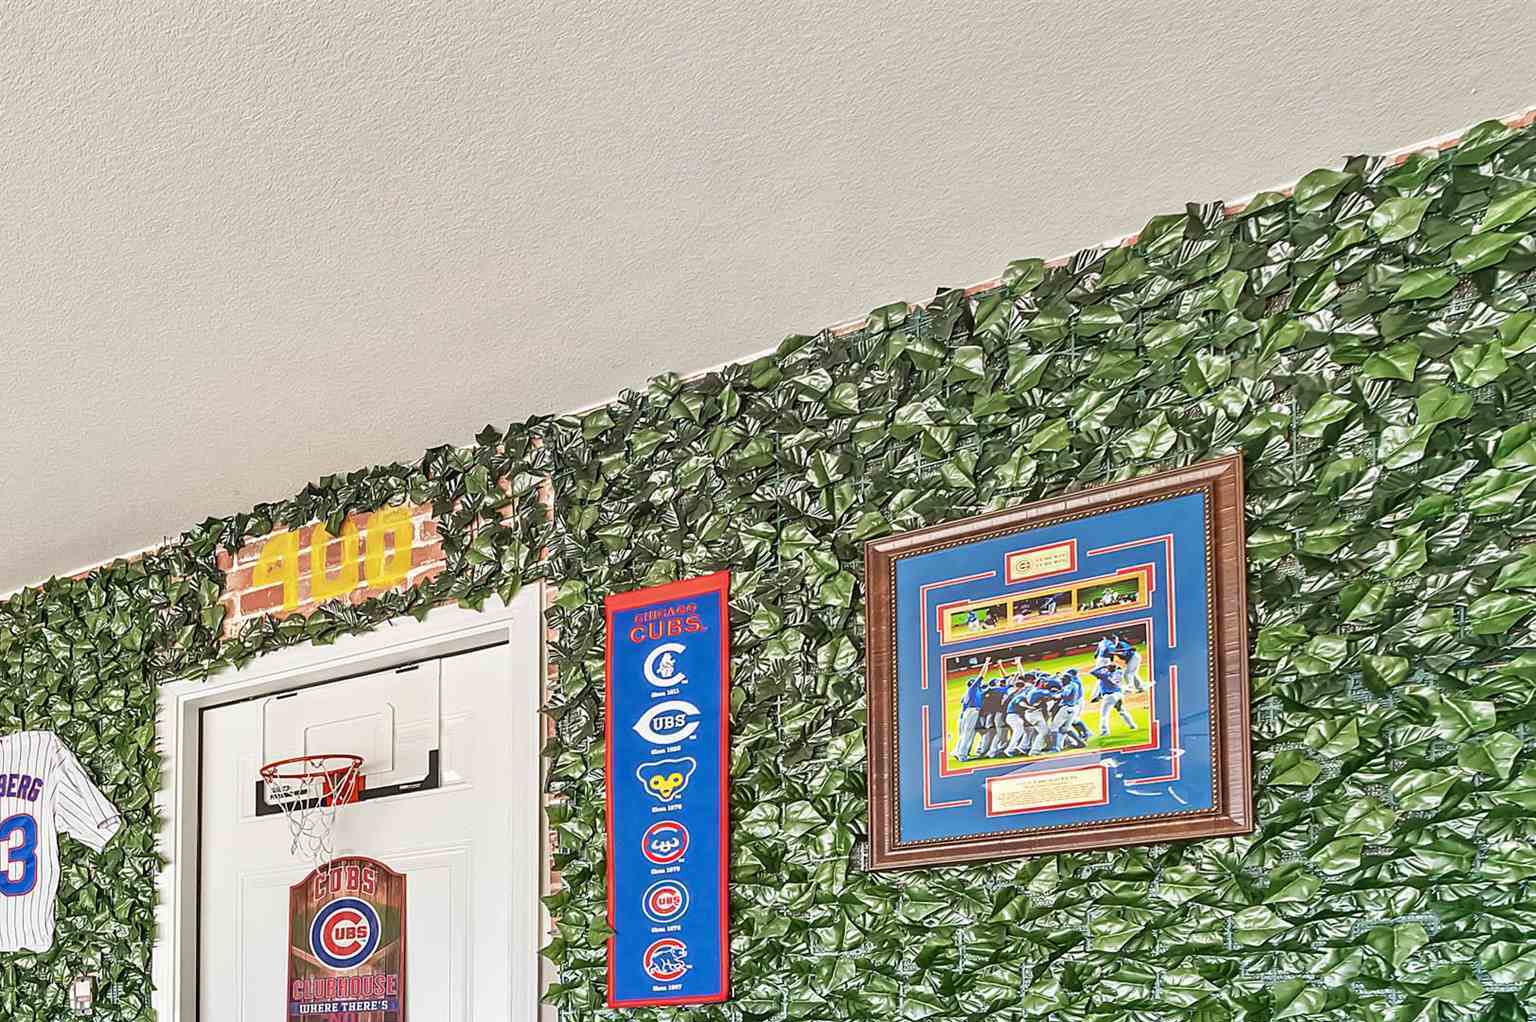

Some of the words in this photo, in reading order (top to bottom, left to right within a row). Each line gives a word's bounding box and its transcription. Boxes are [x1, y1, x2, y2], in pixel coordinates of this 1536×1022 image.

[252, 503, 411, 612] 400
[634, 603, 697, 625] CHICAGO
[629, 614, 702, 644] CUBS
[314, 863, 376, 901] CUBS
[292, 974, 398, 1002] CLUBHOUSE
[299, 1001, 339, 1015] WHERE
[341, 999, 388, 1013] THERE'S
